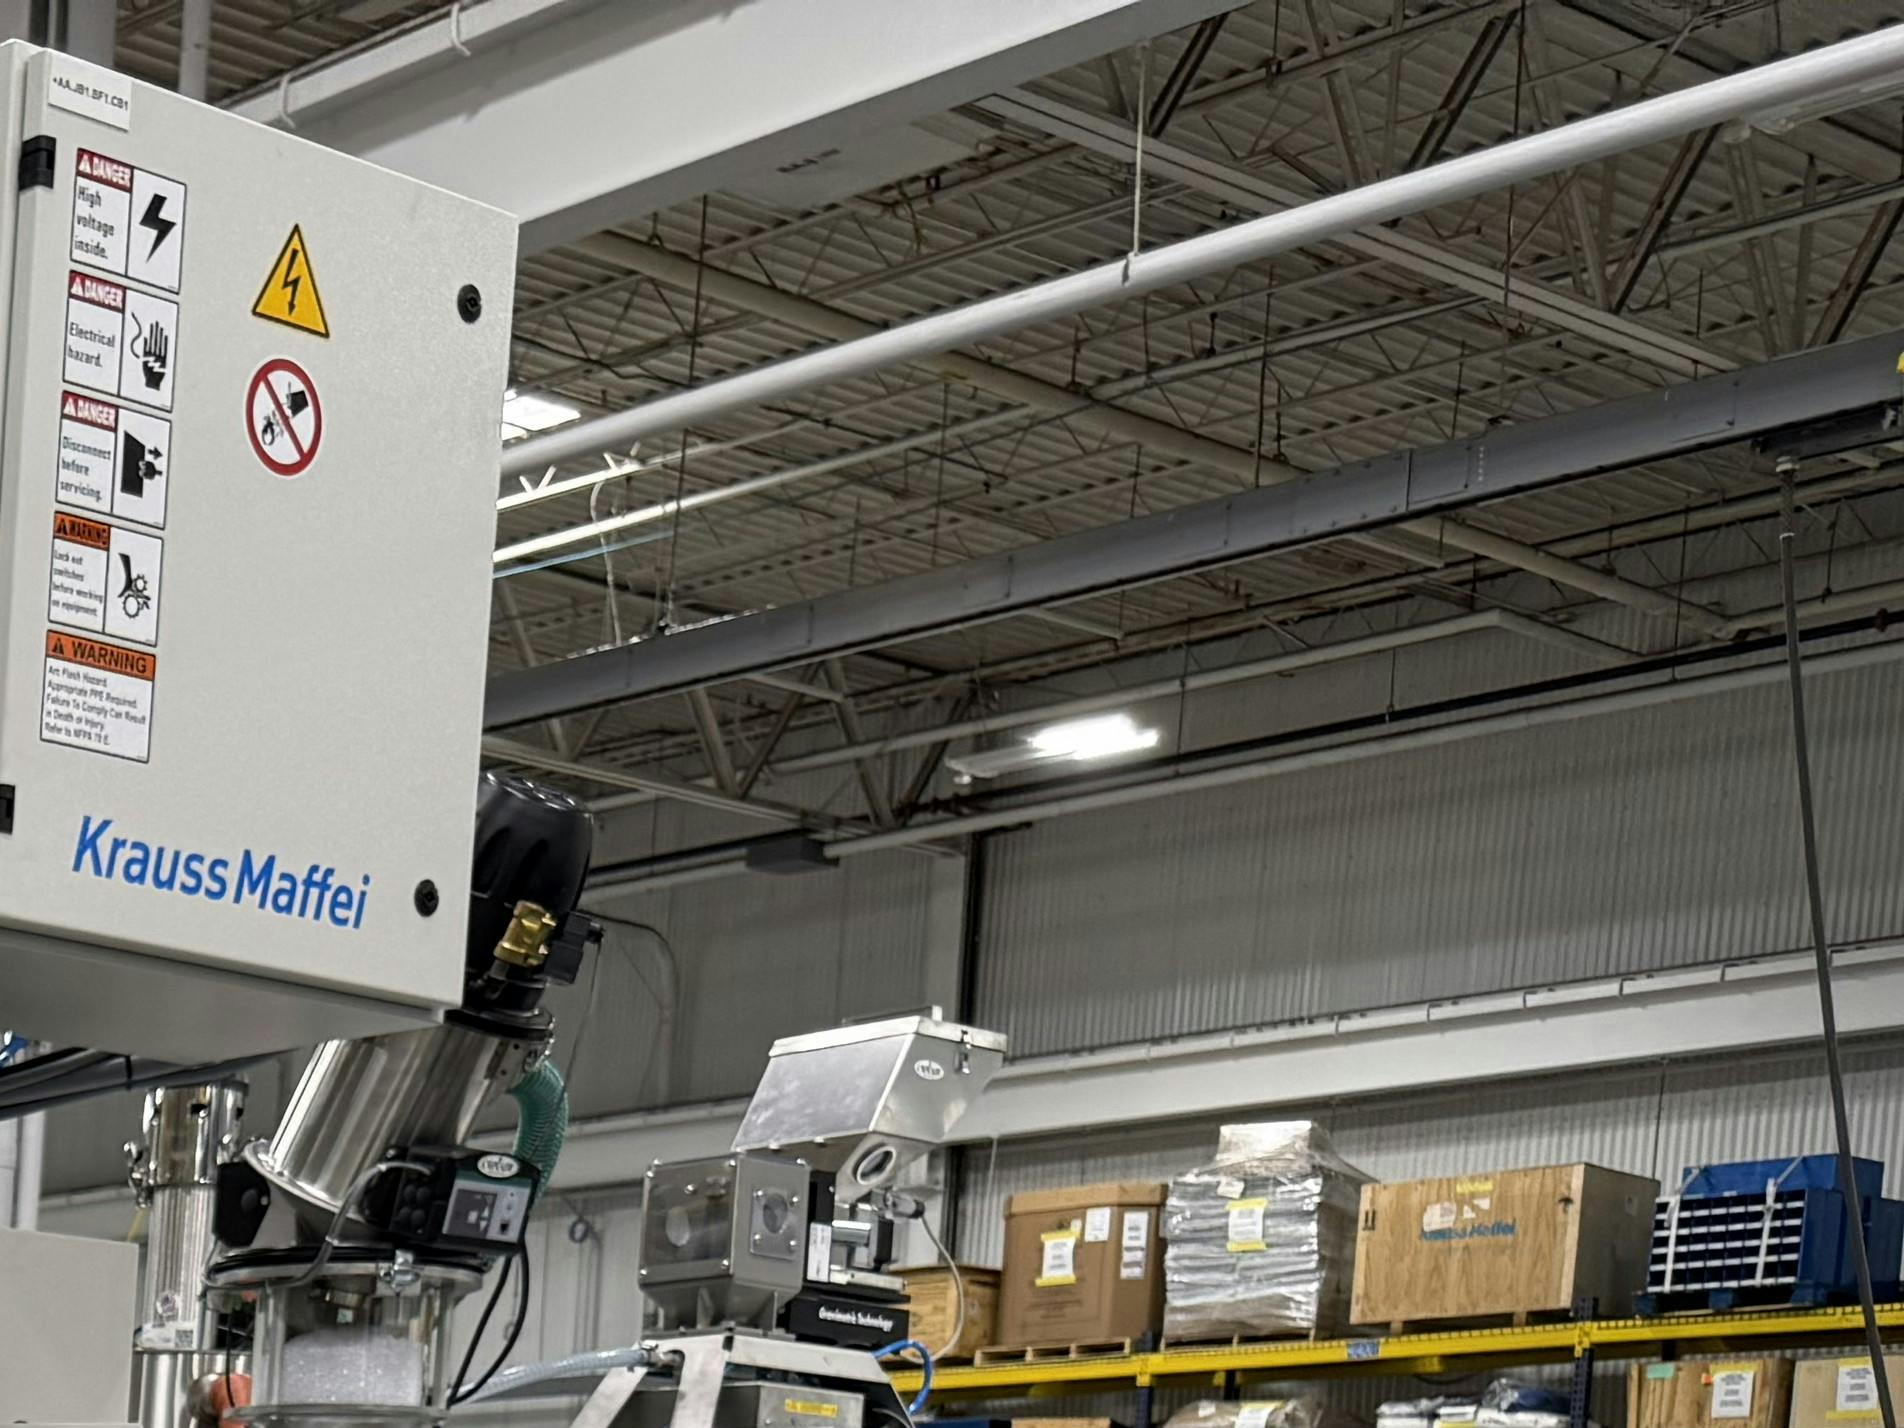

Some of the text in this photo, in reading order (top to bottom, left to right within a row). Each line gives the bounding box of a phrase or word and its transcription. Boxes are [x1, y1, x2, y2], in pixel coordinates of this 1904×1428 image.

[92, 156, 131, 188] DANGER
[78, 185, 101, 208] High
[76, 213, 114, 237] voltage
[75, 235, 108, 259] inside.
[85, 278, 123, 309] DANGER
[69, 322, 115, 348] Electrical
[68, 345, 103, 367] hazard.
[77, 398, 115, 429] DANGER
[62, 436, 111, 460] Disconnect
[61, 458, 90, 476] before
[60, 480, 103, 502] servicing.
[72, 641, 147, 673] WARNING
